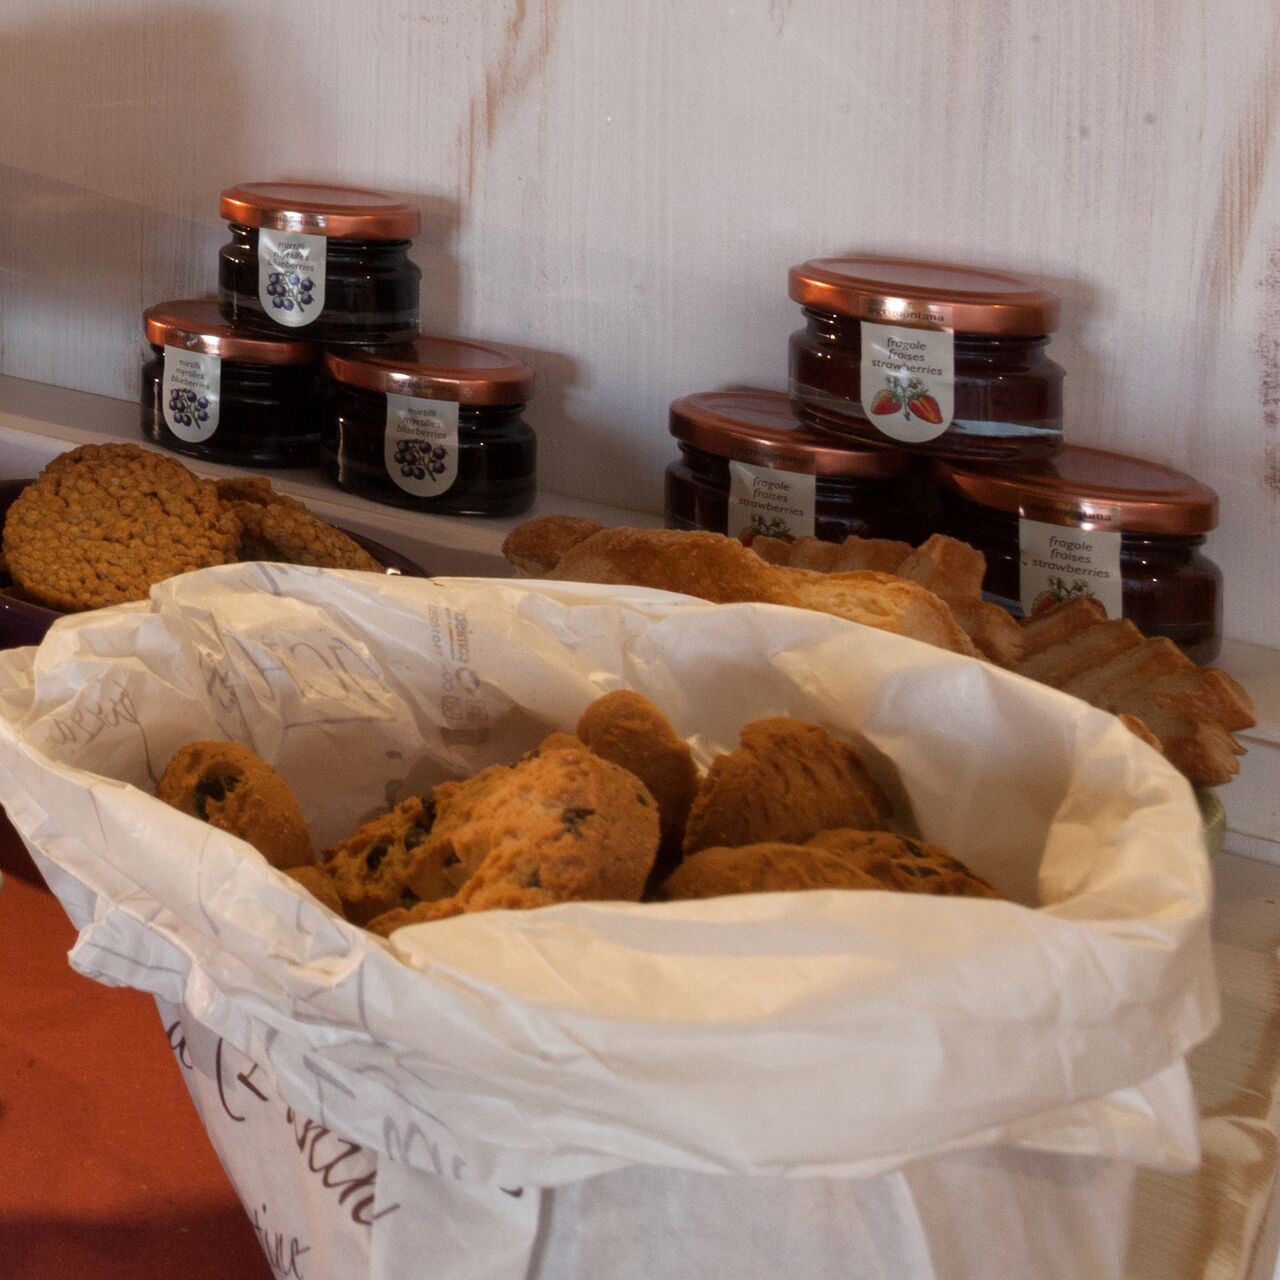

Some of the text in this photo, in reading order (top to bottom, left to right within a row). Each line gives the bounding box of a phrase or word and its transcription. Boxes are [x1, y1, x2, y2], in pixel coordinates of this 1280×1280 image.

[886, 336, 927, 351] fragole
[888, 348, 926, 362] fraises
[871, 359, 943, 376] strawberries
[753, 475, 790, 492] fragole
[753, 488, 788, 503] fraises
[738, 498, 804, 517] strawberries
[1048, 536, 1093, 552] fragole
[1050, 548, 1091, 564] fraises
[1031, 559, 1110, 578] strawberries
